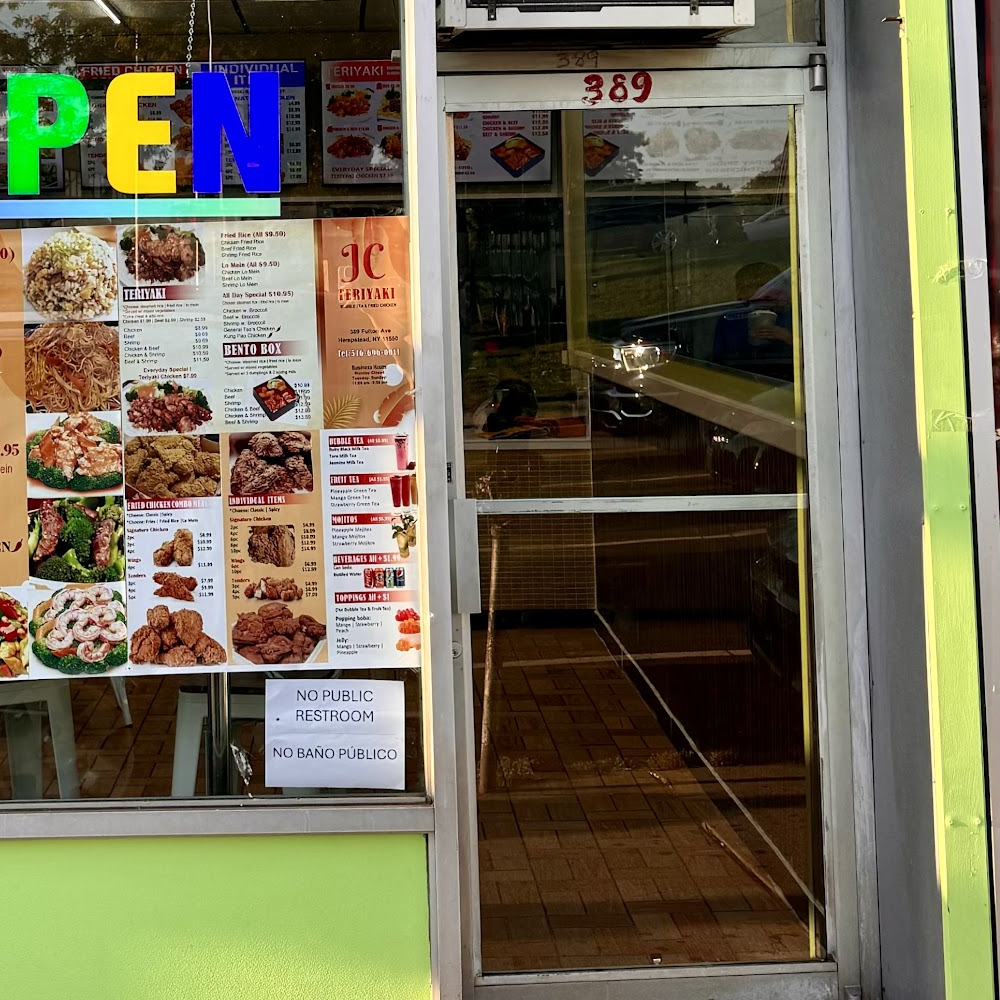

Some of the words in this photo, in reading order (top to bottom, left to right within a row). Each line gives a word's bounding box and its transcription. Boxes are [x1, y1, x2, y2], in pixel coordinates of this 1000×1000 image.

[557, 50, 599, 68] 389
[83, 66, 120, 76] FRIED
[214, 64, 298, 74] INDIVIDUAL
[328, 66, 383, 76] TERIYAKI
[582, 71, 652, 106] 389
[341, 243, 386, 283] JC
[124, 288, 166, 300] TERIYAKI
[340, 288, 394, 300] TERIYAKI
[224, 344, 257, 356] BENTO
[261, 343, 282, 355] BOX
[353, 437, 364, 445] TEA
[349, 475, 359, 483] TEA
[127, 502, 146, 510] FRIED
[146, 501, 170, 509] CHICKEN
[229, 497, 265, 505] INDIVIDUAL
[268, 496, 285, 504] ITEMS
[332, 516, 358, 524] MOJITOS
[333, 555, 367, 563] BEVERAGES
[336, 594, 366, 602] TOPPINGS
[297, 690, 318, 701] NO
[323, 690, 374, 702] PUBLIC
[296, 710, 374, 722] RESTROOM
[273, 747, 293, 758] NO
[298, 746, 335, 759] BAÑO
[339, 746, 397, 760] PÚBLICO
